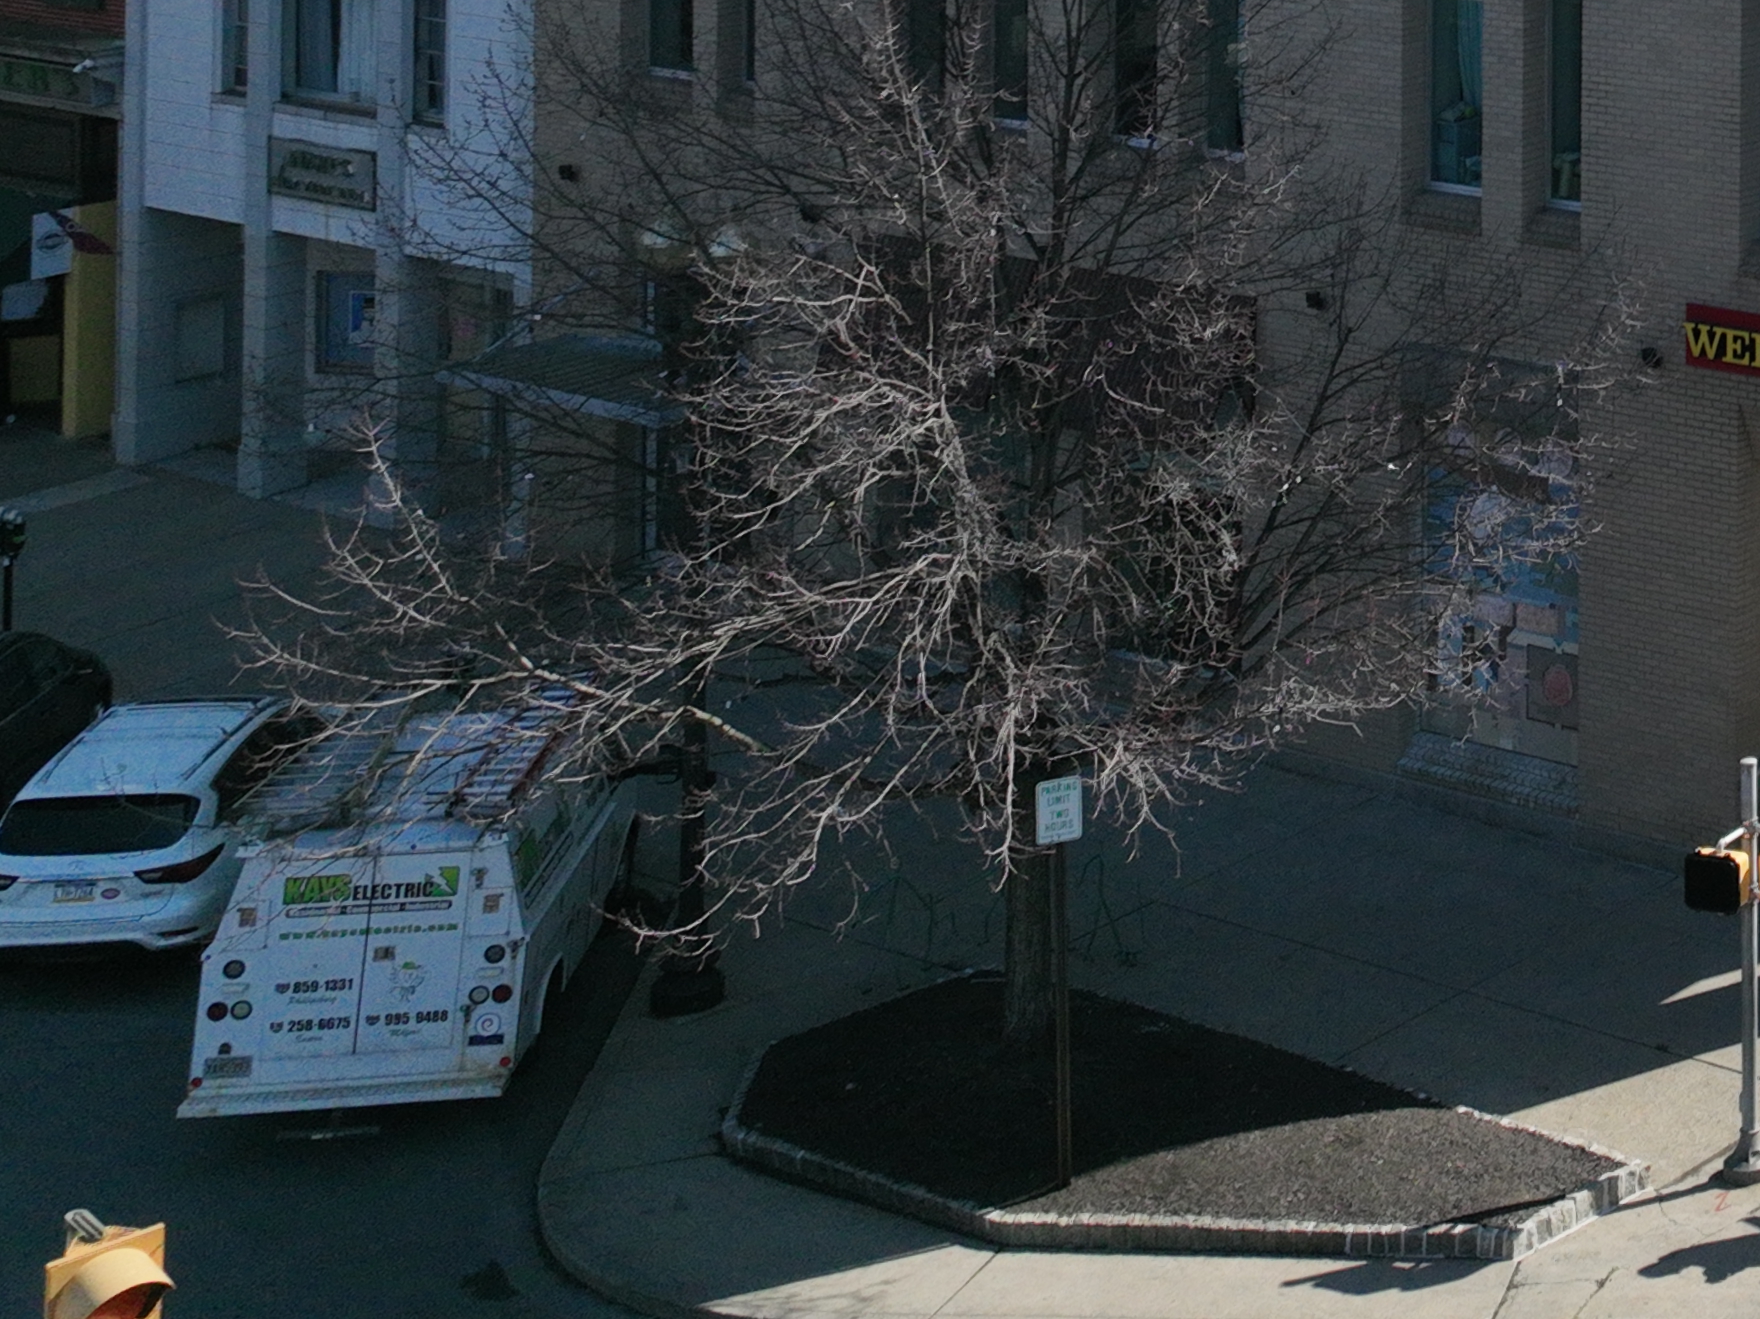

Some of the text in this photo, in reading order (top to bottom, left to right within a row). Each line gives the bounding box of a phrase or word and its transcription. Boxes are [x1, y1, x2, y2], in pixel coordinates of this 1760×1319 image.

[1041, 781, 1078, 796] PARKING
[1047, 794, 1071, 807] LIMIT
[353, 881, 434, 901] ELECTRIC
[292, 978, 354, 994] 859-1331
[287, 1016, 351, 1033] 258-6675
